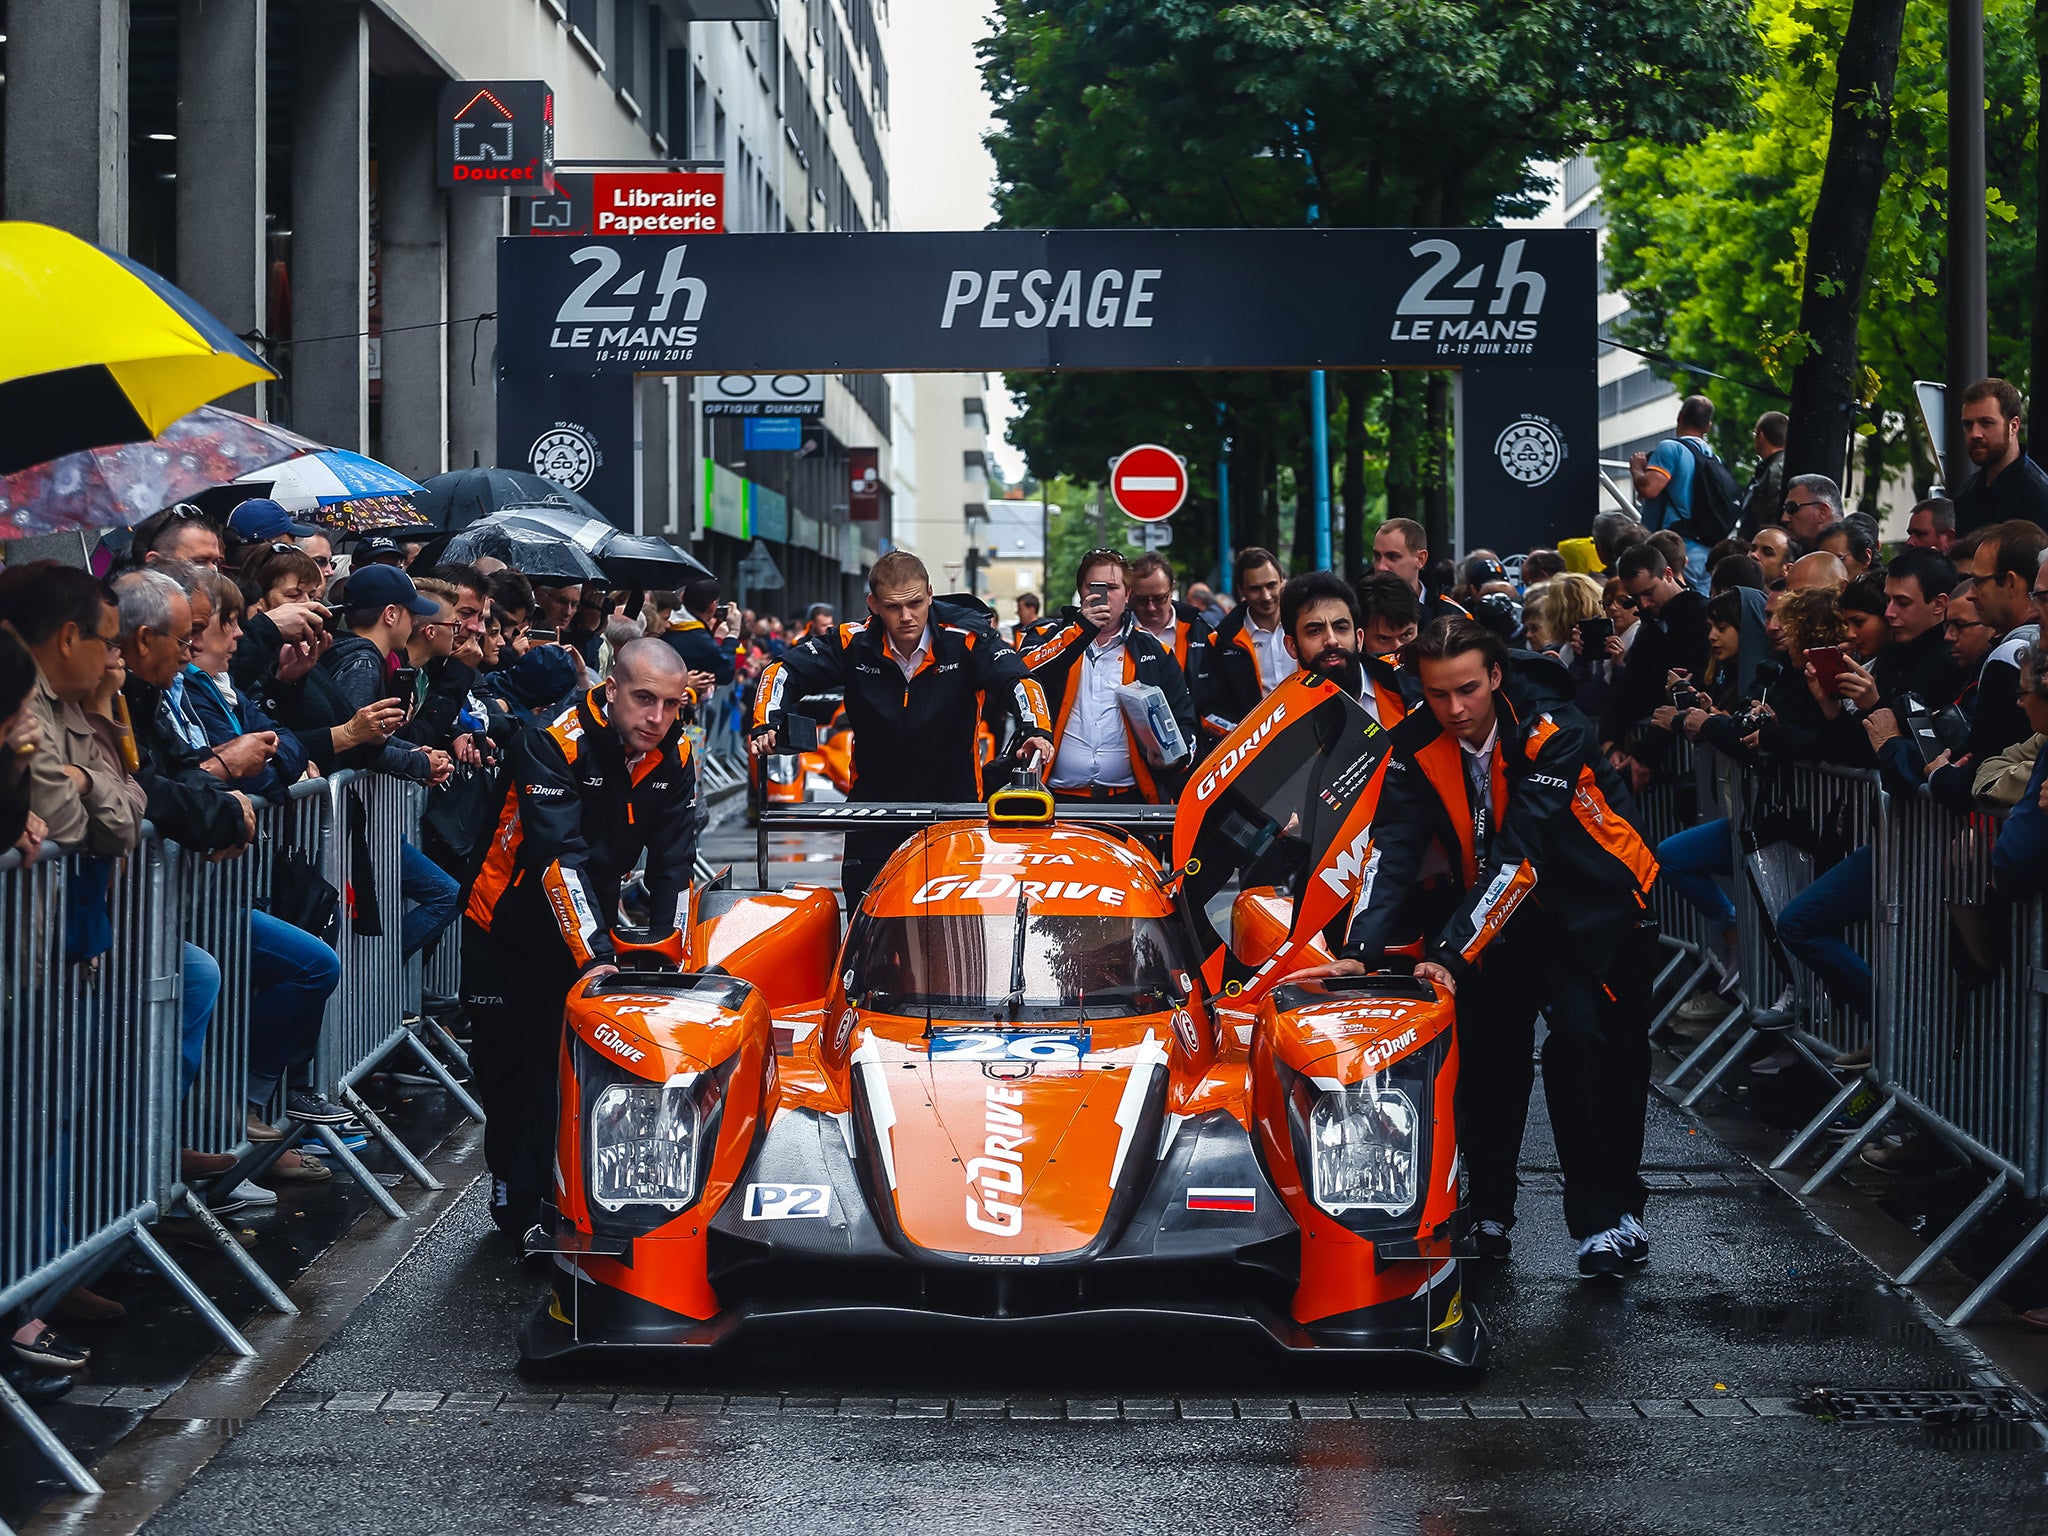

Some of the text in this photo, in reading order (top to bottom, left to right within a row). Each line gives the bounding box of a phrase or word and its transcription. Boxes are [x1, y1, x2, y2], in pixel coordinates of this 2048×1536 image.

[453, 164, 534, 181] Doucet
[613, 189, 717, 208] Librairie
[599, 212, 717, 235] Papeterie
[555, 244, 708, 323] 24h
[1396, 239, 1546, 315] 24h
[940, 268, 1163, 330] PESAGE
[550, 326, 698, 348] LE MANS
[1390, 320, 1538, 340] LE MANS
[595, 349, 693, 361] 18-19 JUIN 2016
[1473, 343, 1500, 354] JUIN
[1504, 343, 1533, 354] 2016
[704, 403, 822, 415] OPTIQUE DUMONT
[856, 663, 881, 675] JOTA
[1196, 702, 1288, 801] G-DRIVE
[1345, 756, 1375, 786] STEVENS
[1528, 773, 1569, 789] JOTA
[525, 784, 565, 796] G-DRIVE
[1350, 773, 1367, 792] RAST
[1575, 787, 1604, 826] JOTA
[1477, 807, 1486, 840] JOTA
[959, 854, 1075, 865] JOTA
[912, 873, 1127, 906] G-DRIVE
[468, 995, 504, 1005] JOTA
[593, 1023, 646, 1063] G-DRIVE
[942, 1035, 1080, 1061] 26
[1363, 1027, 1418, 1067] G-DRIVE
[966, 1085, 1033, 1237] G-DRIVE
[751, 1186, 822, 1217] P2
[968, 1255, 1023, 1263] ORECA
